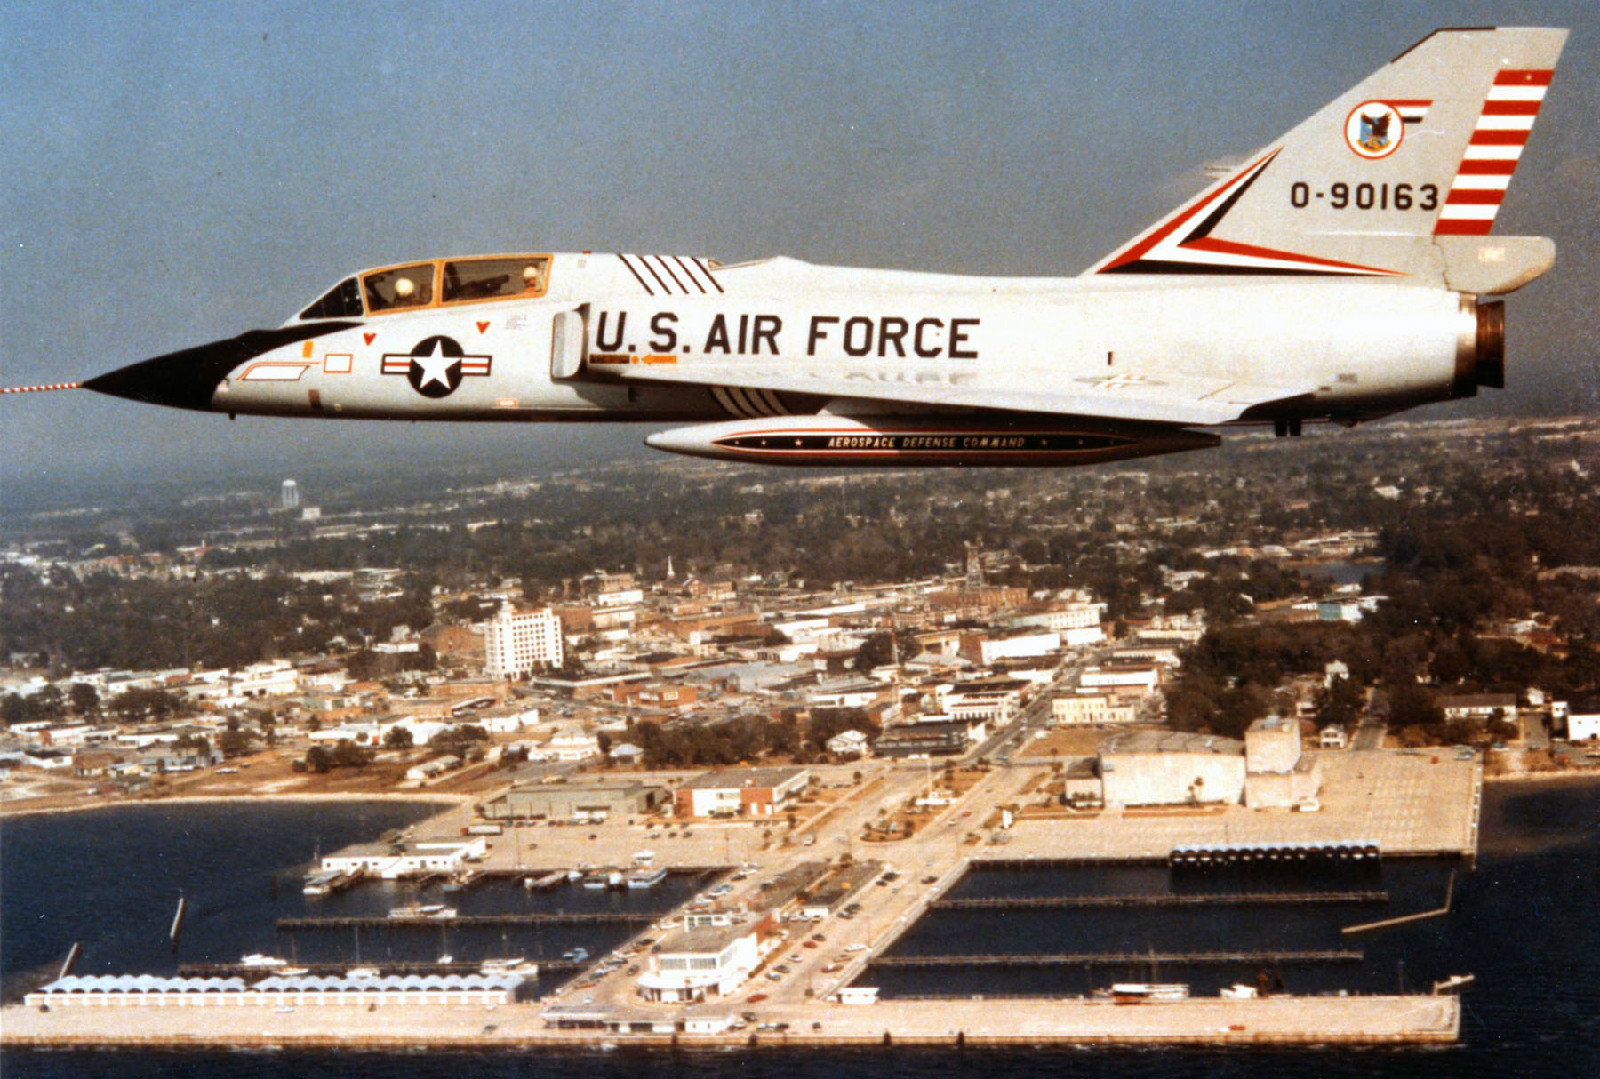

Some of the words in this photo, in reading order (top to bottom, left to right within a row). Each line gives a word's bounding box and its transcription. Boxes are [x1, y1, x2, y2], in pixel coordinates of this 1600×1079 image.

[595, 311, 691, 353] U.S.
[703, 313, 783, 356] AIR
[807, 315, 981, 359] FORCE
[827, 436, 896, 449] AEROSPACE
[902, 437, 956, 449] DEFENSE
[962, 437, 1026, 449] COMMAND
